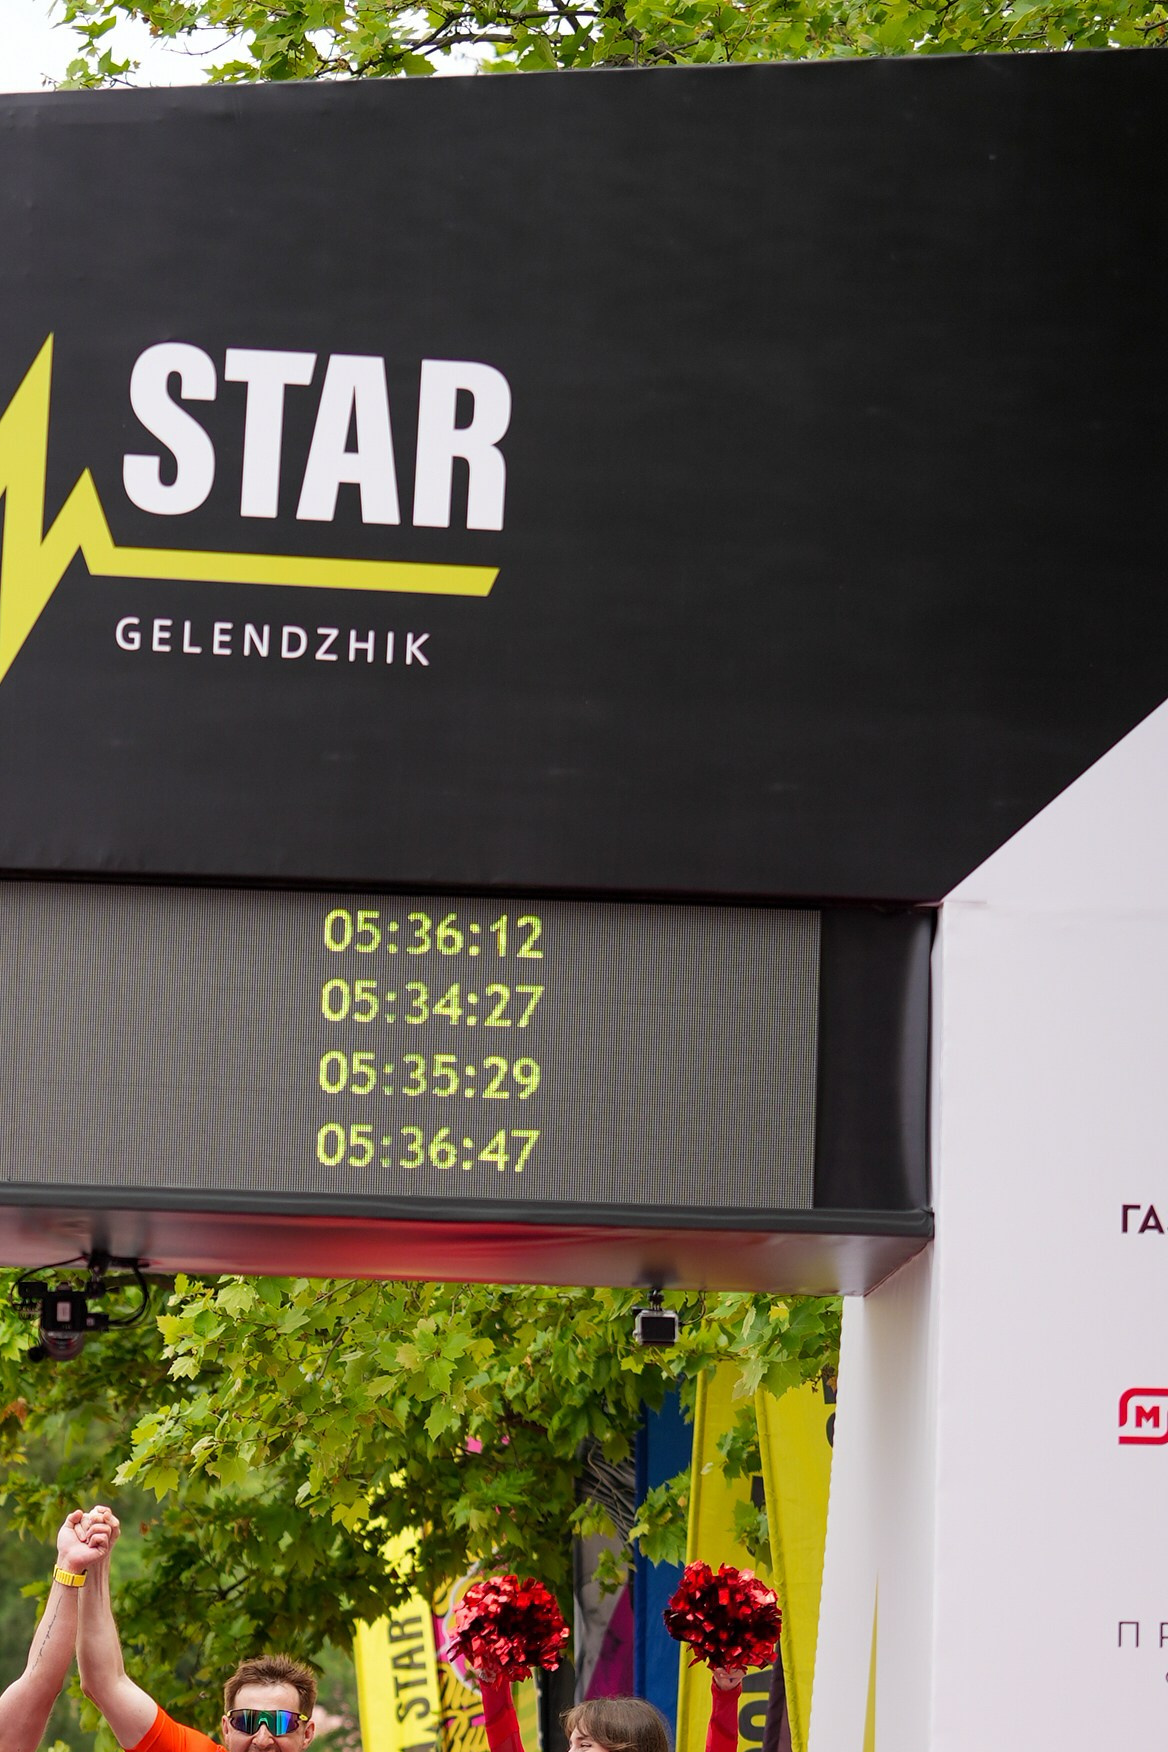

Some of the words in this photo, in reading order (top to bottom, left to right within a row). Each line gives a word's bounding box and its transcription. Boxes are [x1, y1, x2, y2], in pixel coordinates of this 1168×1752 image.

[123, 341, 512, 532] STAR
[114, 617, 432, 667] GELENDZHIK
[324, 908, 544, 959] 05:36:12
[321, 978, 545, 1027] 05:34:27
[319, 1050, 541, 1099] 05:35:29
[316, 1122, 541, 1172] 05:36:47
